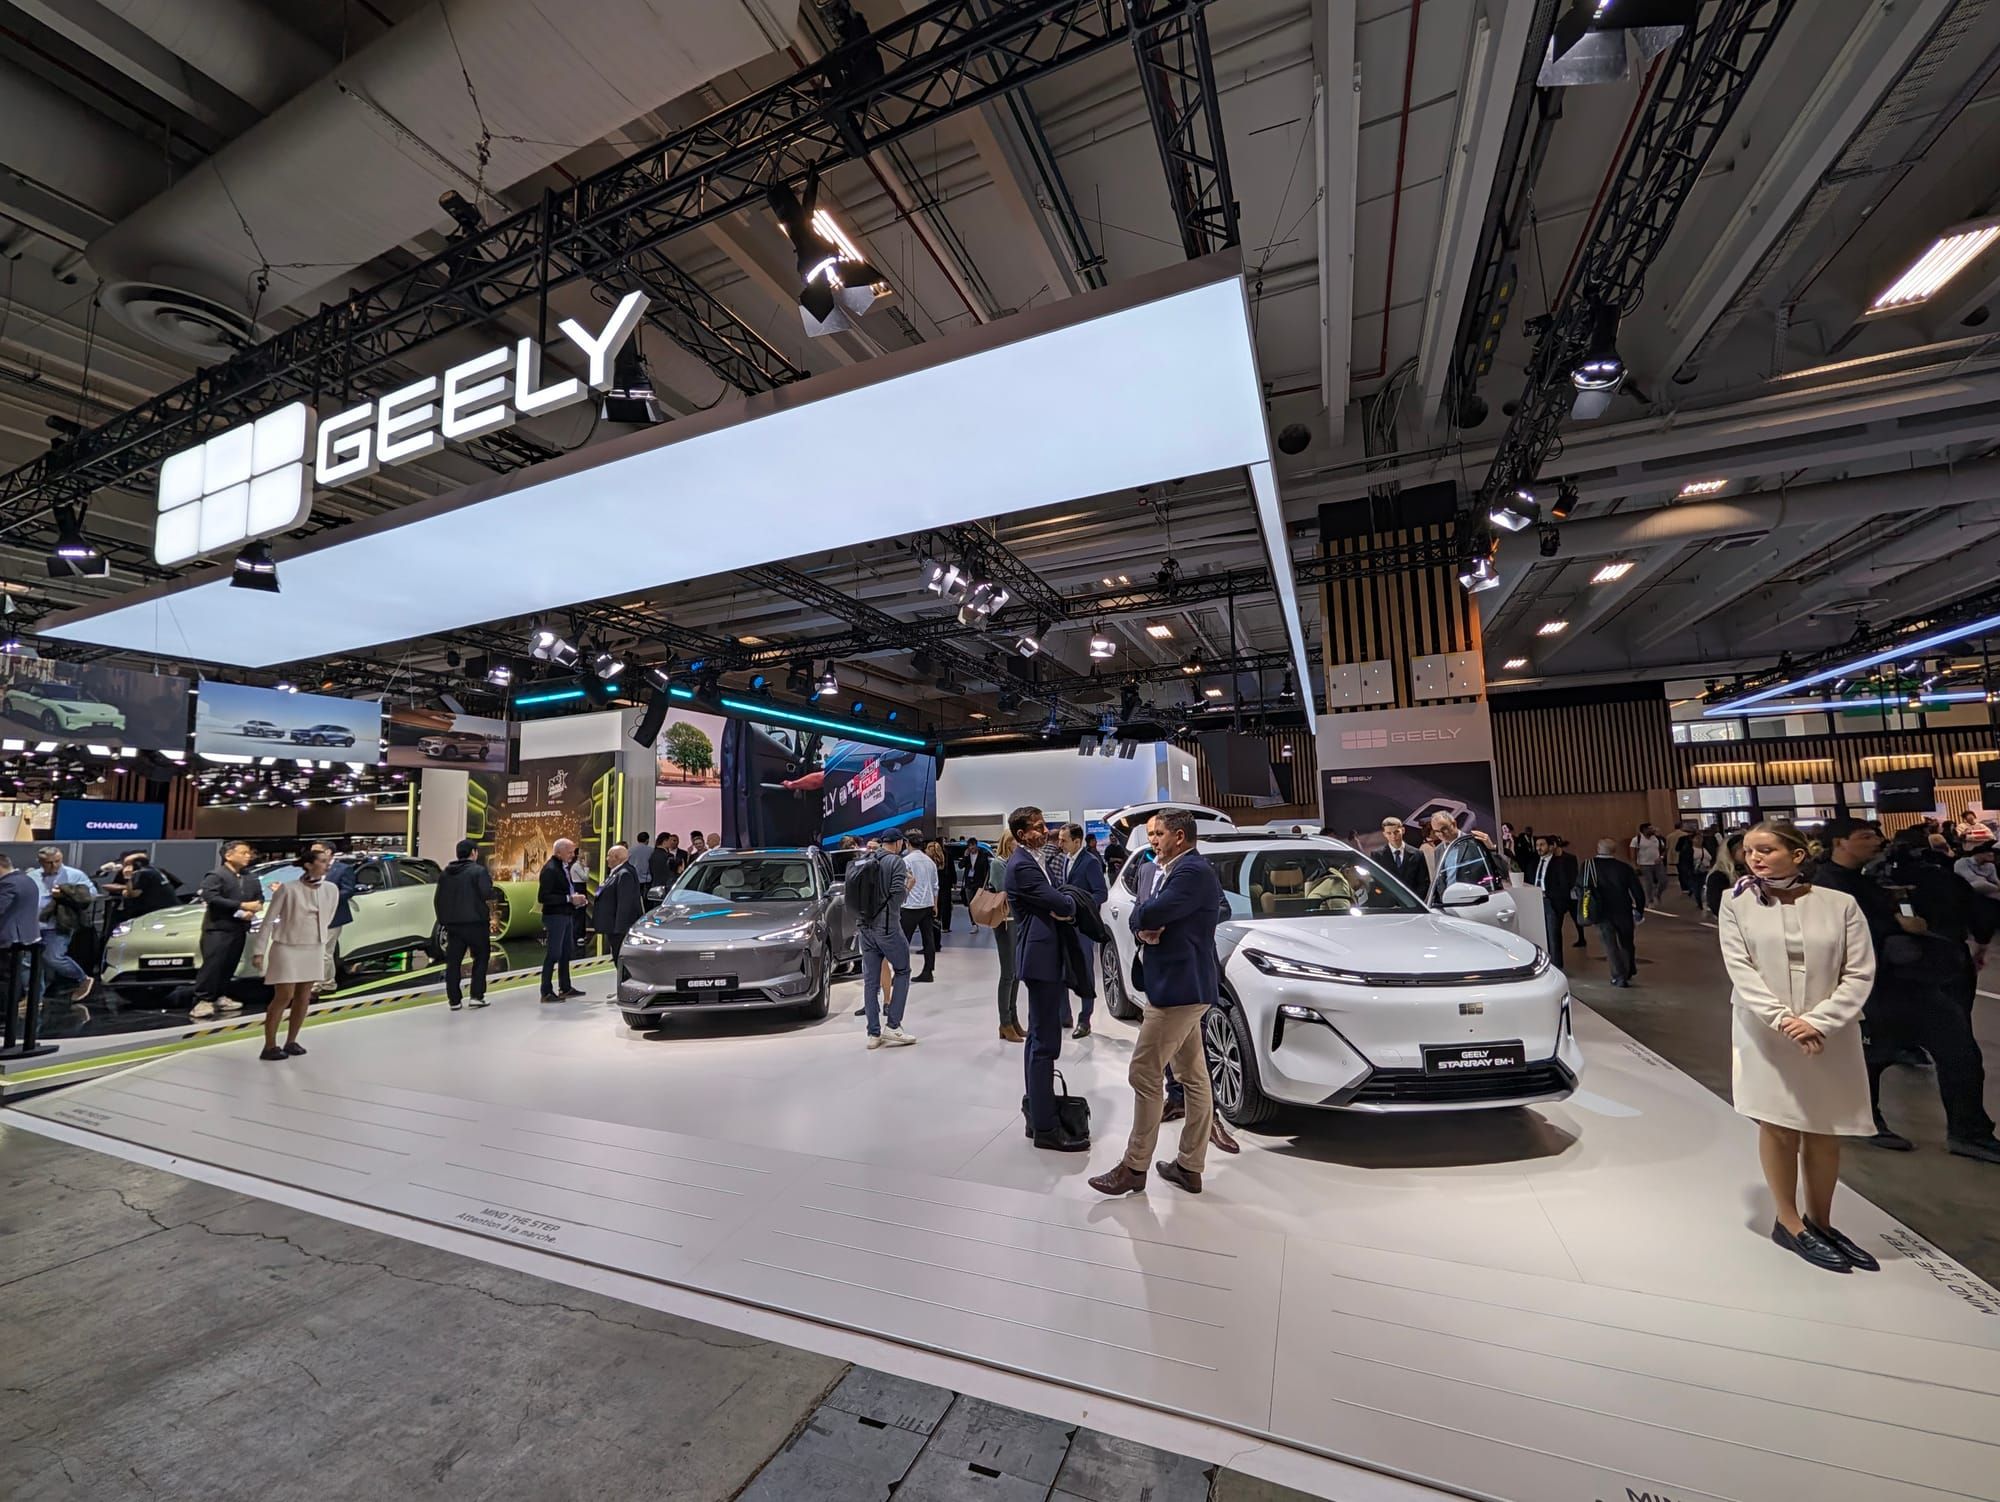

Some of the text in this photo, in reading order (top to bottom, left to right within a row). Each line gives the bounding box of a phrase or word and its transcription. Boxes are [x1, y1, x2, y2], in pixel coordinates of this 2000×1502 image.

[316, 289, 651, 488] GEELY
[1391, 727, 1462, 743] GEELY
[86, 821, 138, 830] CHANGAN
[687, 980, 713, 988] GEELY
[1461, 1050, 1489, 1059] GEELY
[1438, 1059, 1492, 1070] STARRAY
[456, 1212, 501, 1229] Attention
[480, 1207, 561, 1232] MIND THE STEP
[1880, 1233, 1999, 1315] MIND THE STEP
